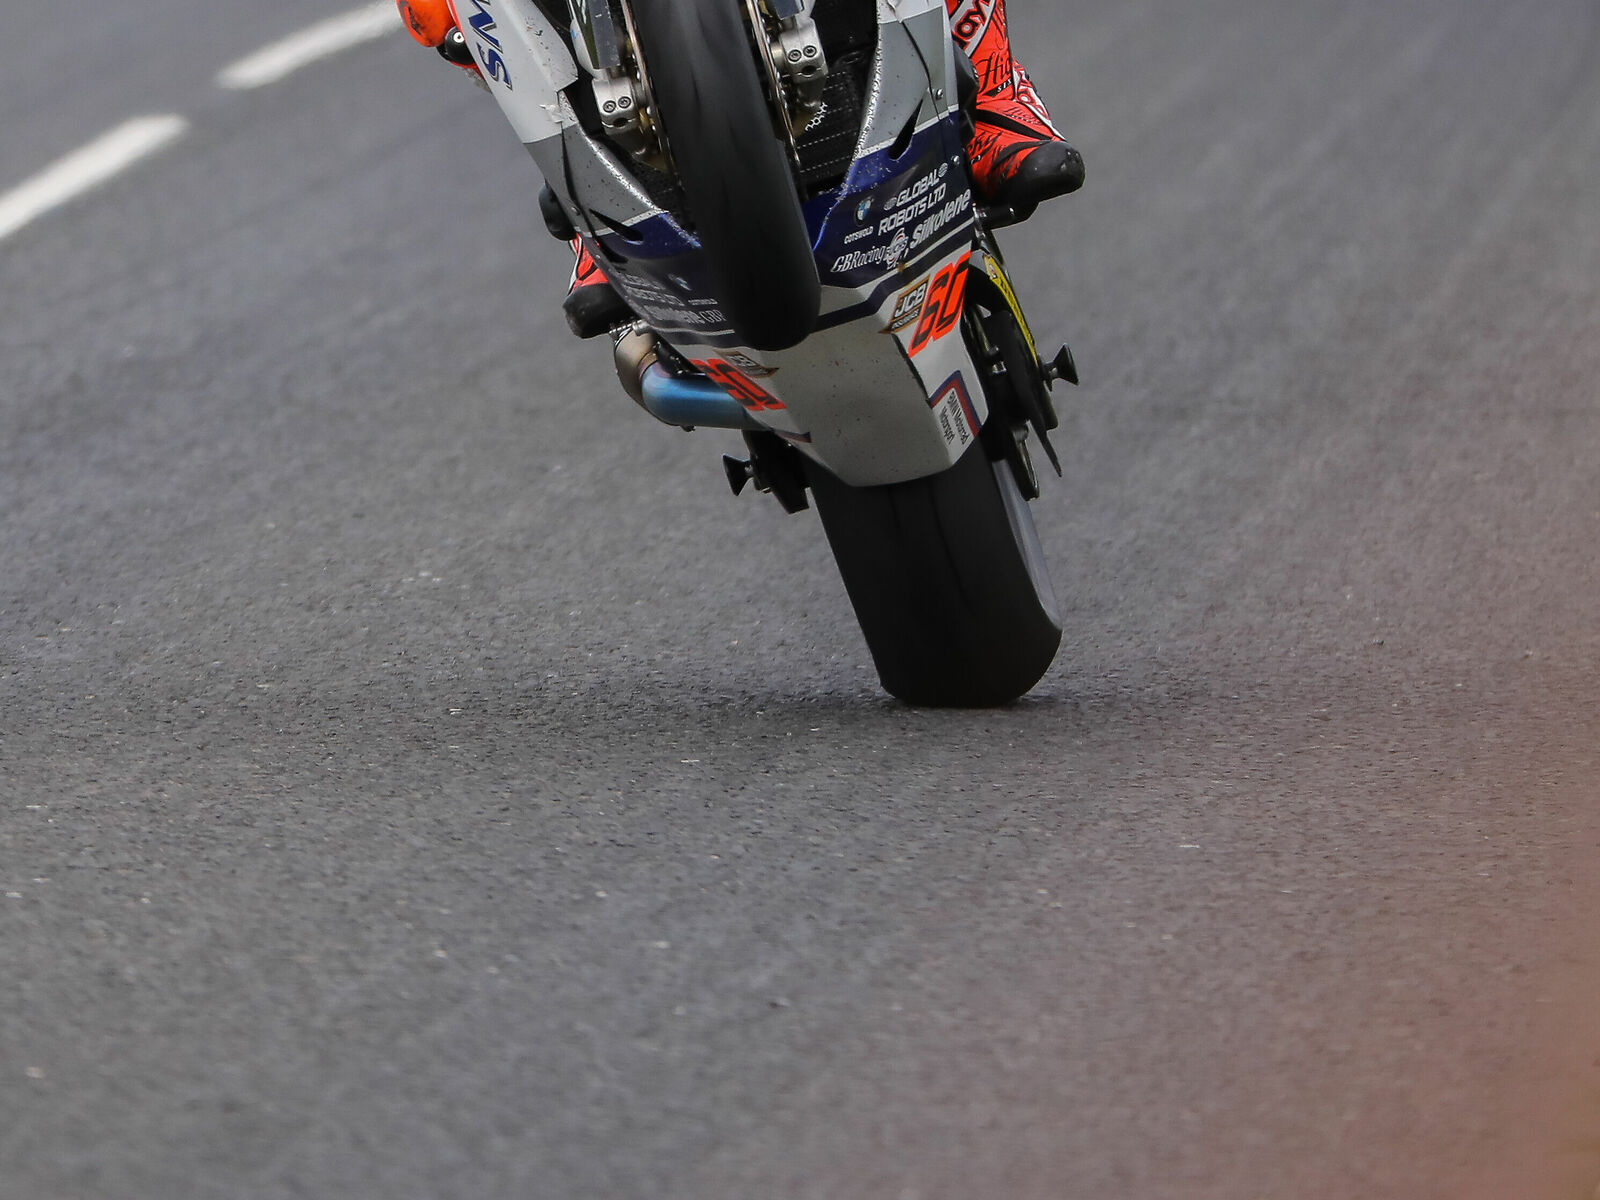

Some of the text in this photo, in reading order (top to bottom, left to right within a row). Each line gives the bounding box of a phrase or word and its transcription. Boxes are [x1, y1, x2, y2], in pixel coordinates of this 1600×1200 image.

[896, 169, 940, 207] GLOBAL
[877, 182, 947, 236] ROBOTS LTD
[909, 188, 971, 249] Silkolene
[843, 226, 874, 244] COTSWOLD
[830, 246, 886, 273] GBRacing
[894, 283, 927, 317] JCB
[911, 254, 971, 351] 60
